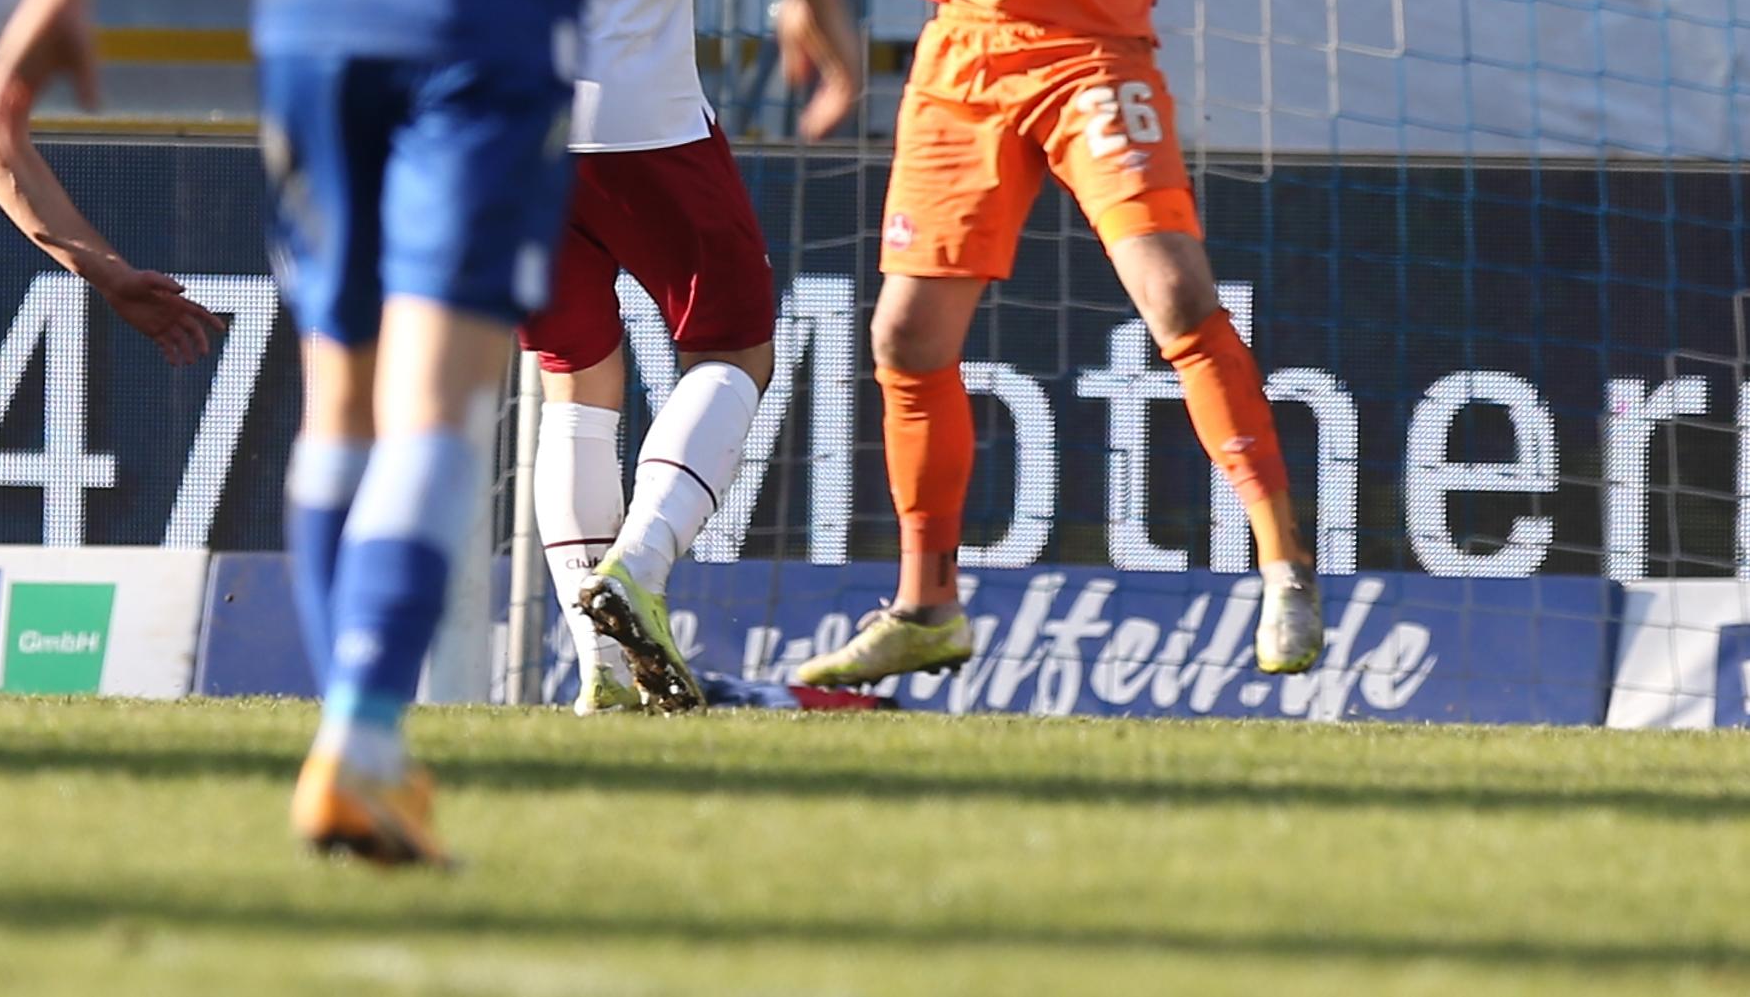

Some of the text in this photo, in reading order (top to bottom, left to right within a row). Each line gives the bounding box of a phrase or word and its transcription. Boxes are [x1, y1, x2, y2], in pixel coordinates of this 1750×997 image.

[1076, 81, 1164, 158] 26
[612, 266, 1750, 584] Mother
[17, 629, 101, 654] GmbH
